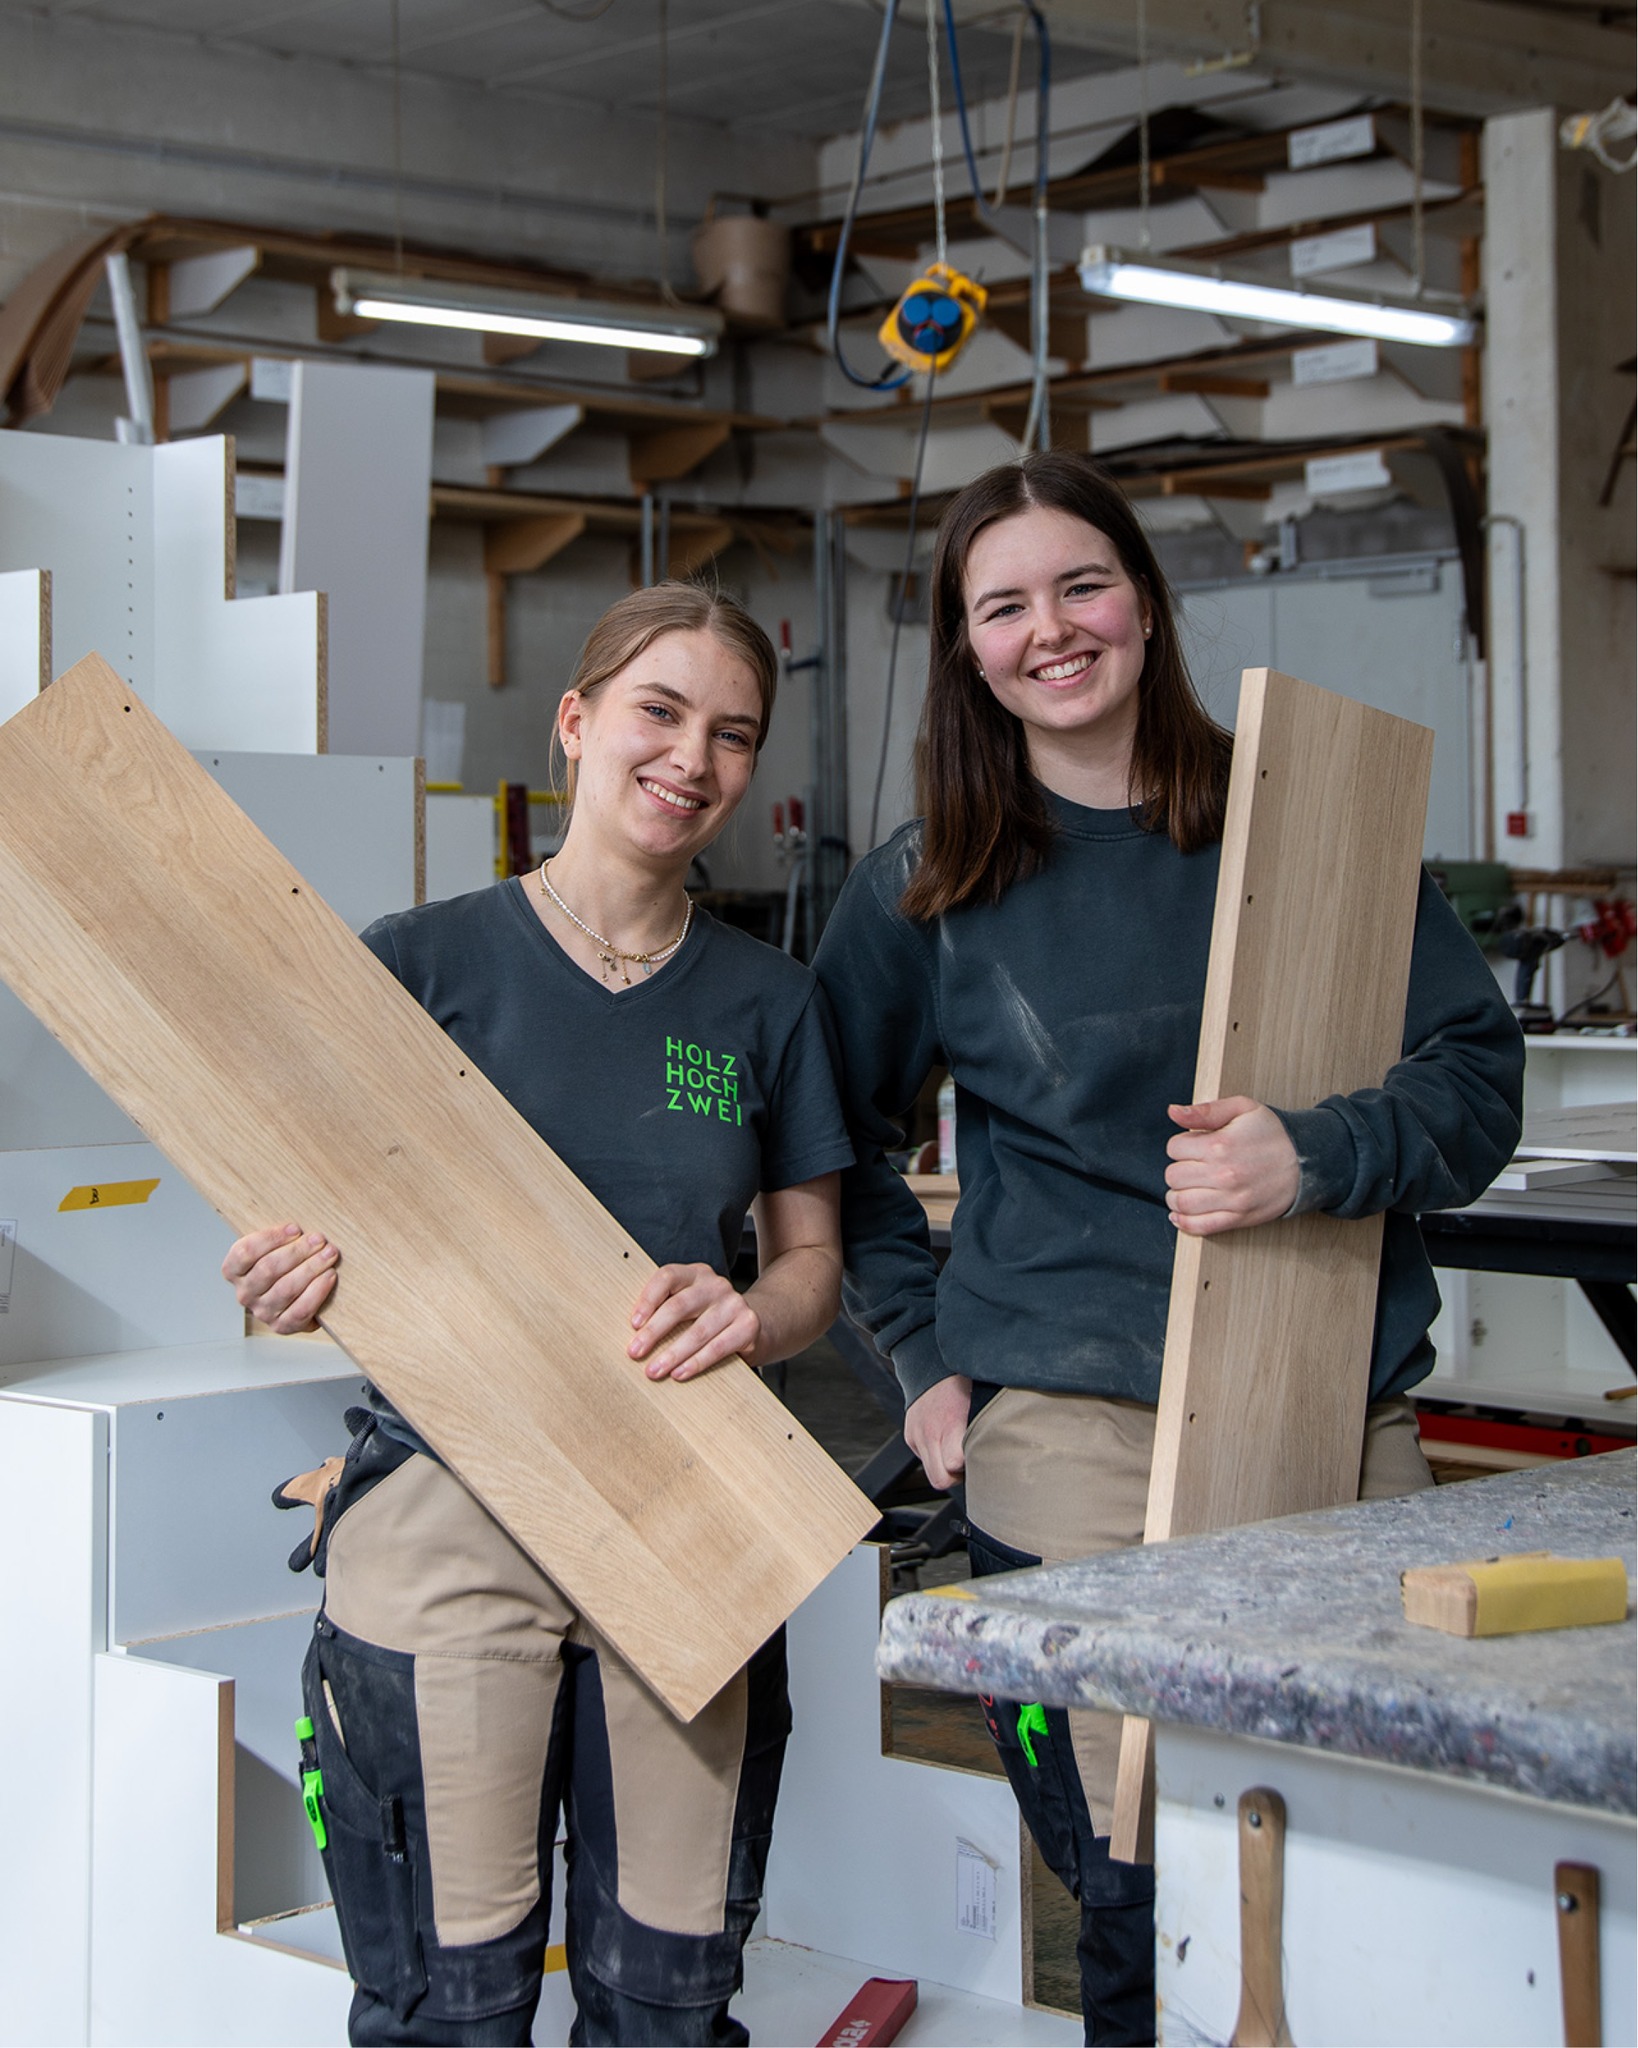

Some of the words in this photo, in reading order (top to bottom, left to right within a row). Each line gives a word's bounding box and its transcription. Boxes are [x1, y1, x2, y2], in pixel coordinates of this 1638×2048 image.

[666, 1036, 738, 1077] HOLZ
[666, 1061, 738, 1103] HOCH
[666, 1087, 742, 1127] ZWEI
